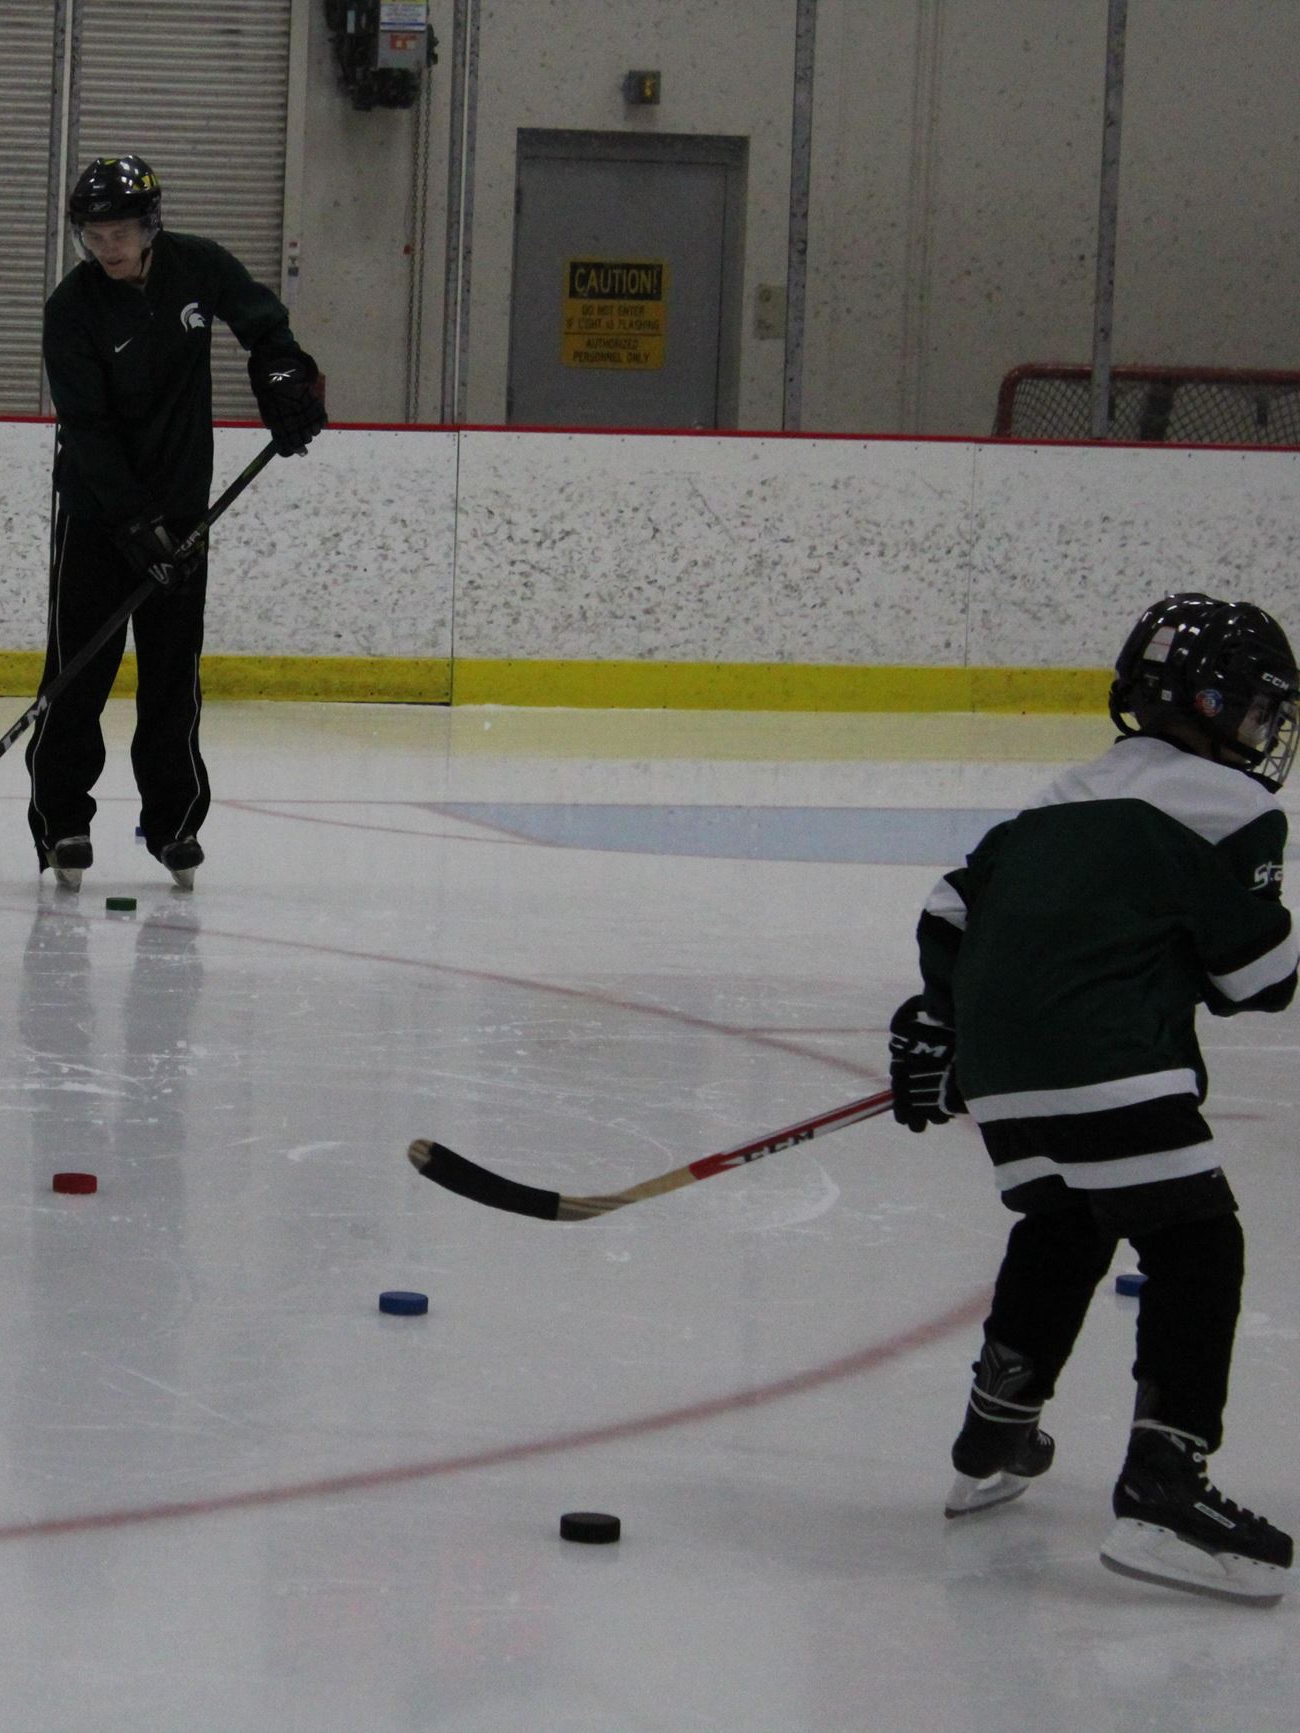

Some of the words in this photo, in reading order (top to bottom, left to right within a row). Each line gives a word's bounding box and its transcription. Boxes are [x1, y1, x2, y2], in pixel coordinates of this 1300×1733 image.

[574, 267, 657, 295] CAUTION!
[581, 304, 594, 316] DO
[597, 304, 614, 316] NOT
[618, 304, 645, 317] ENTER
[619, 319, 661, 331] FLASHING
[585, 338, 639, 350] AUTHORIZED
[572, 351, 623, 364] PERSONNEL
[627, 351, 650, 364] ONLY
[1260, 671, 1290, 691] CCM
